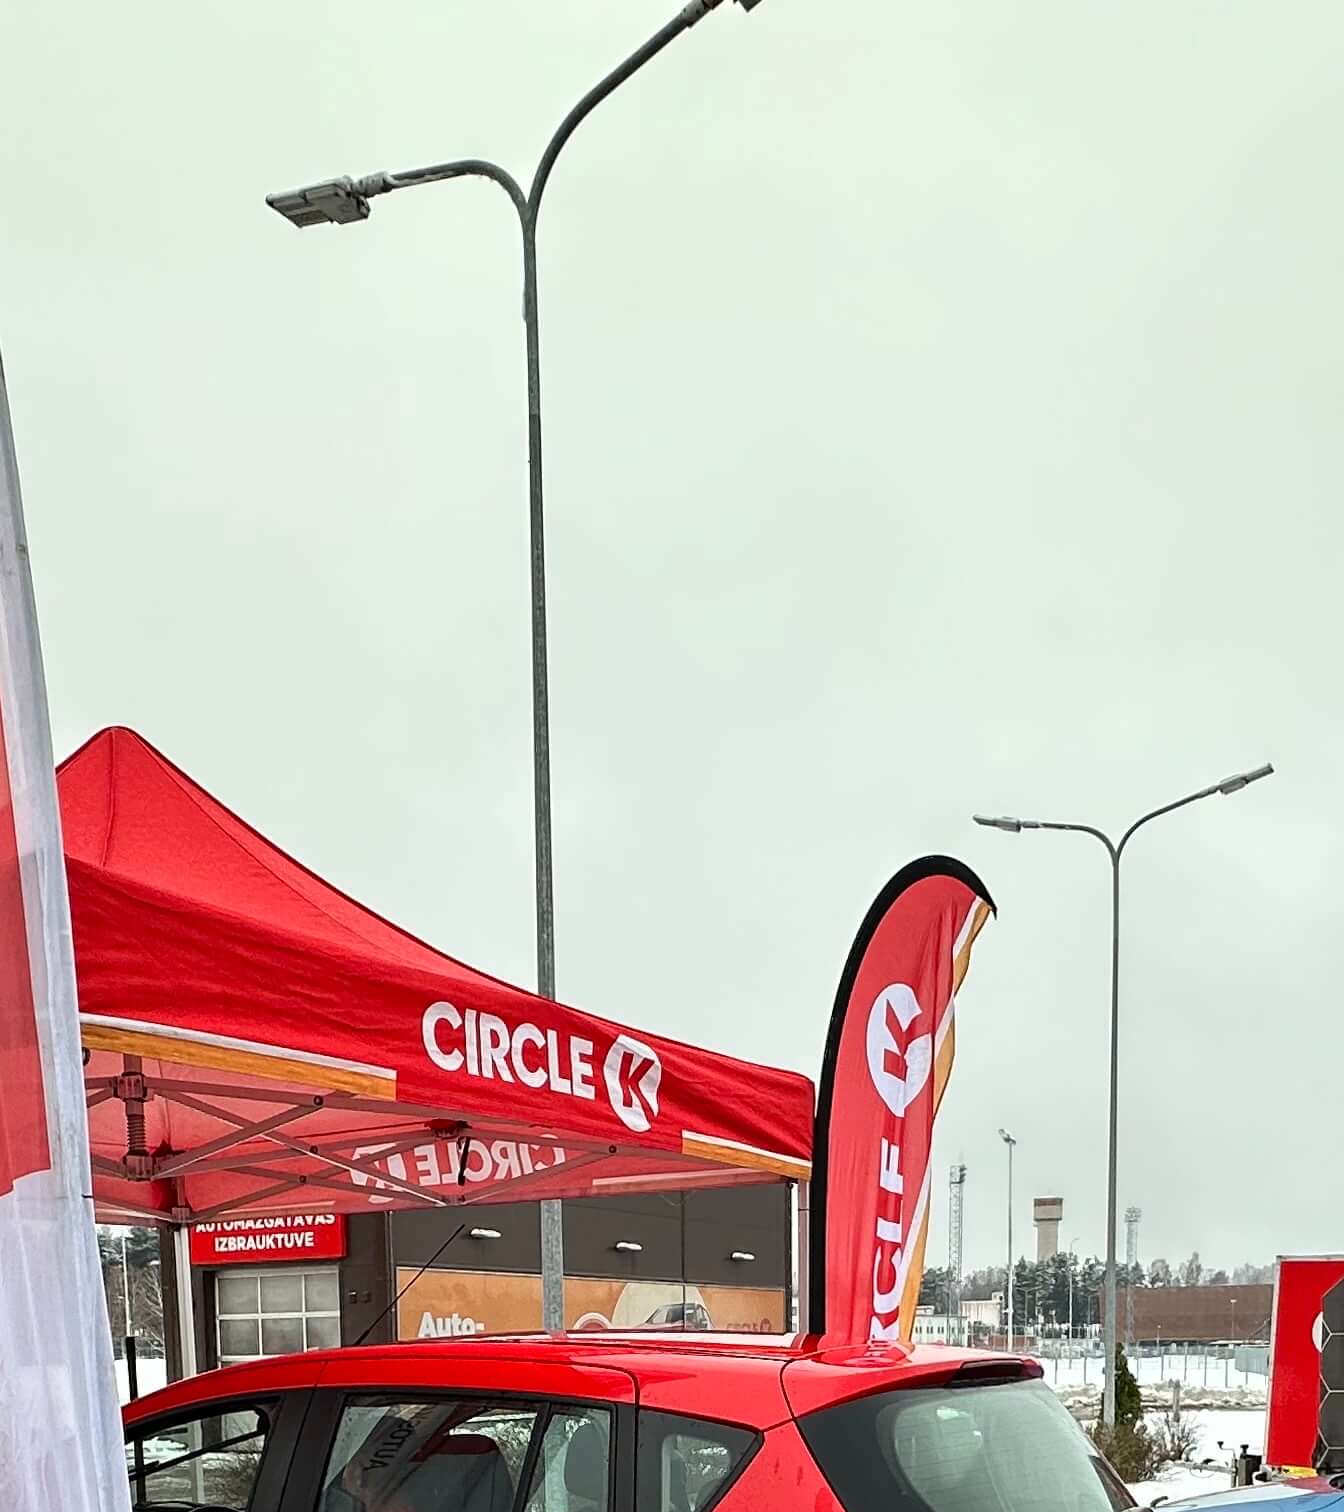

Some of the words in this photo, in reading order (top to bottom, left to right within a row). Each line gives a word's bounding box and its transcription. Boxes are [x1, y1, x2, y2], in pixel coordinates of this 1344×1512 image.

[421, 1000, 598, 1101] CIRCLE
[214, 1231, 314, 1253] IZBRAUKTUVE
[418, 1311, 484, 1339] Auto-
